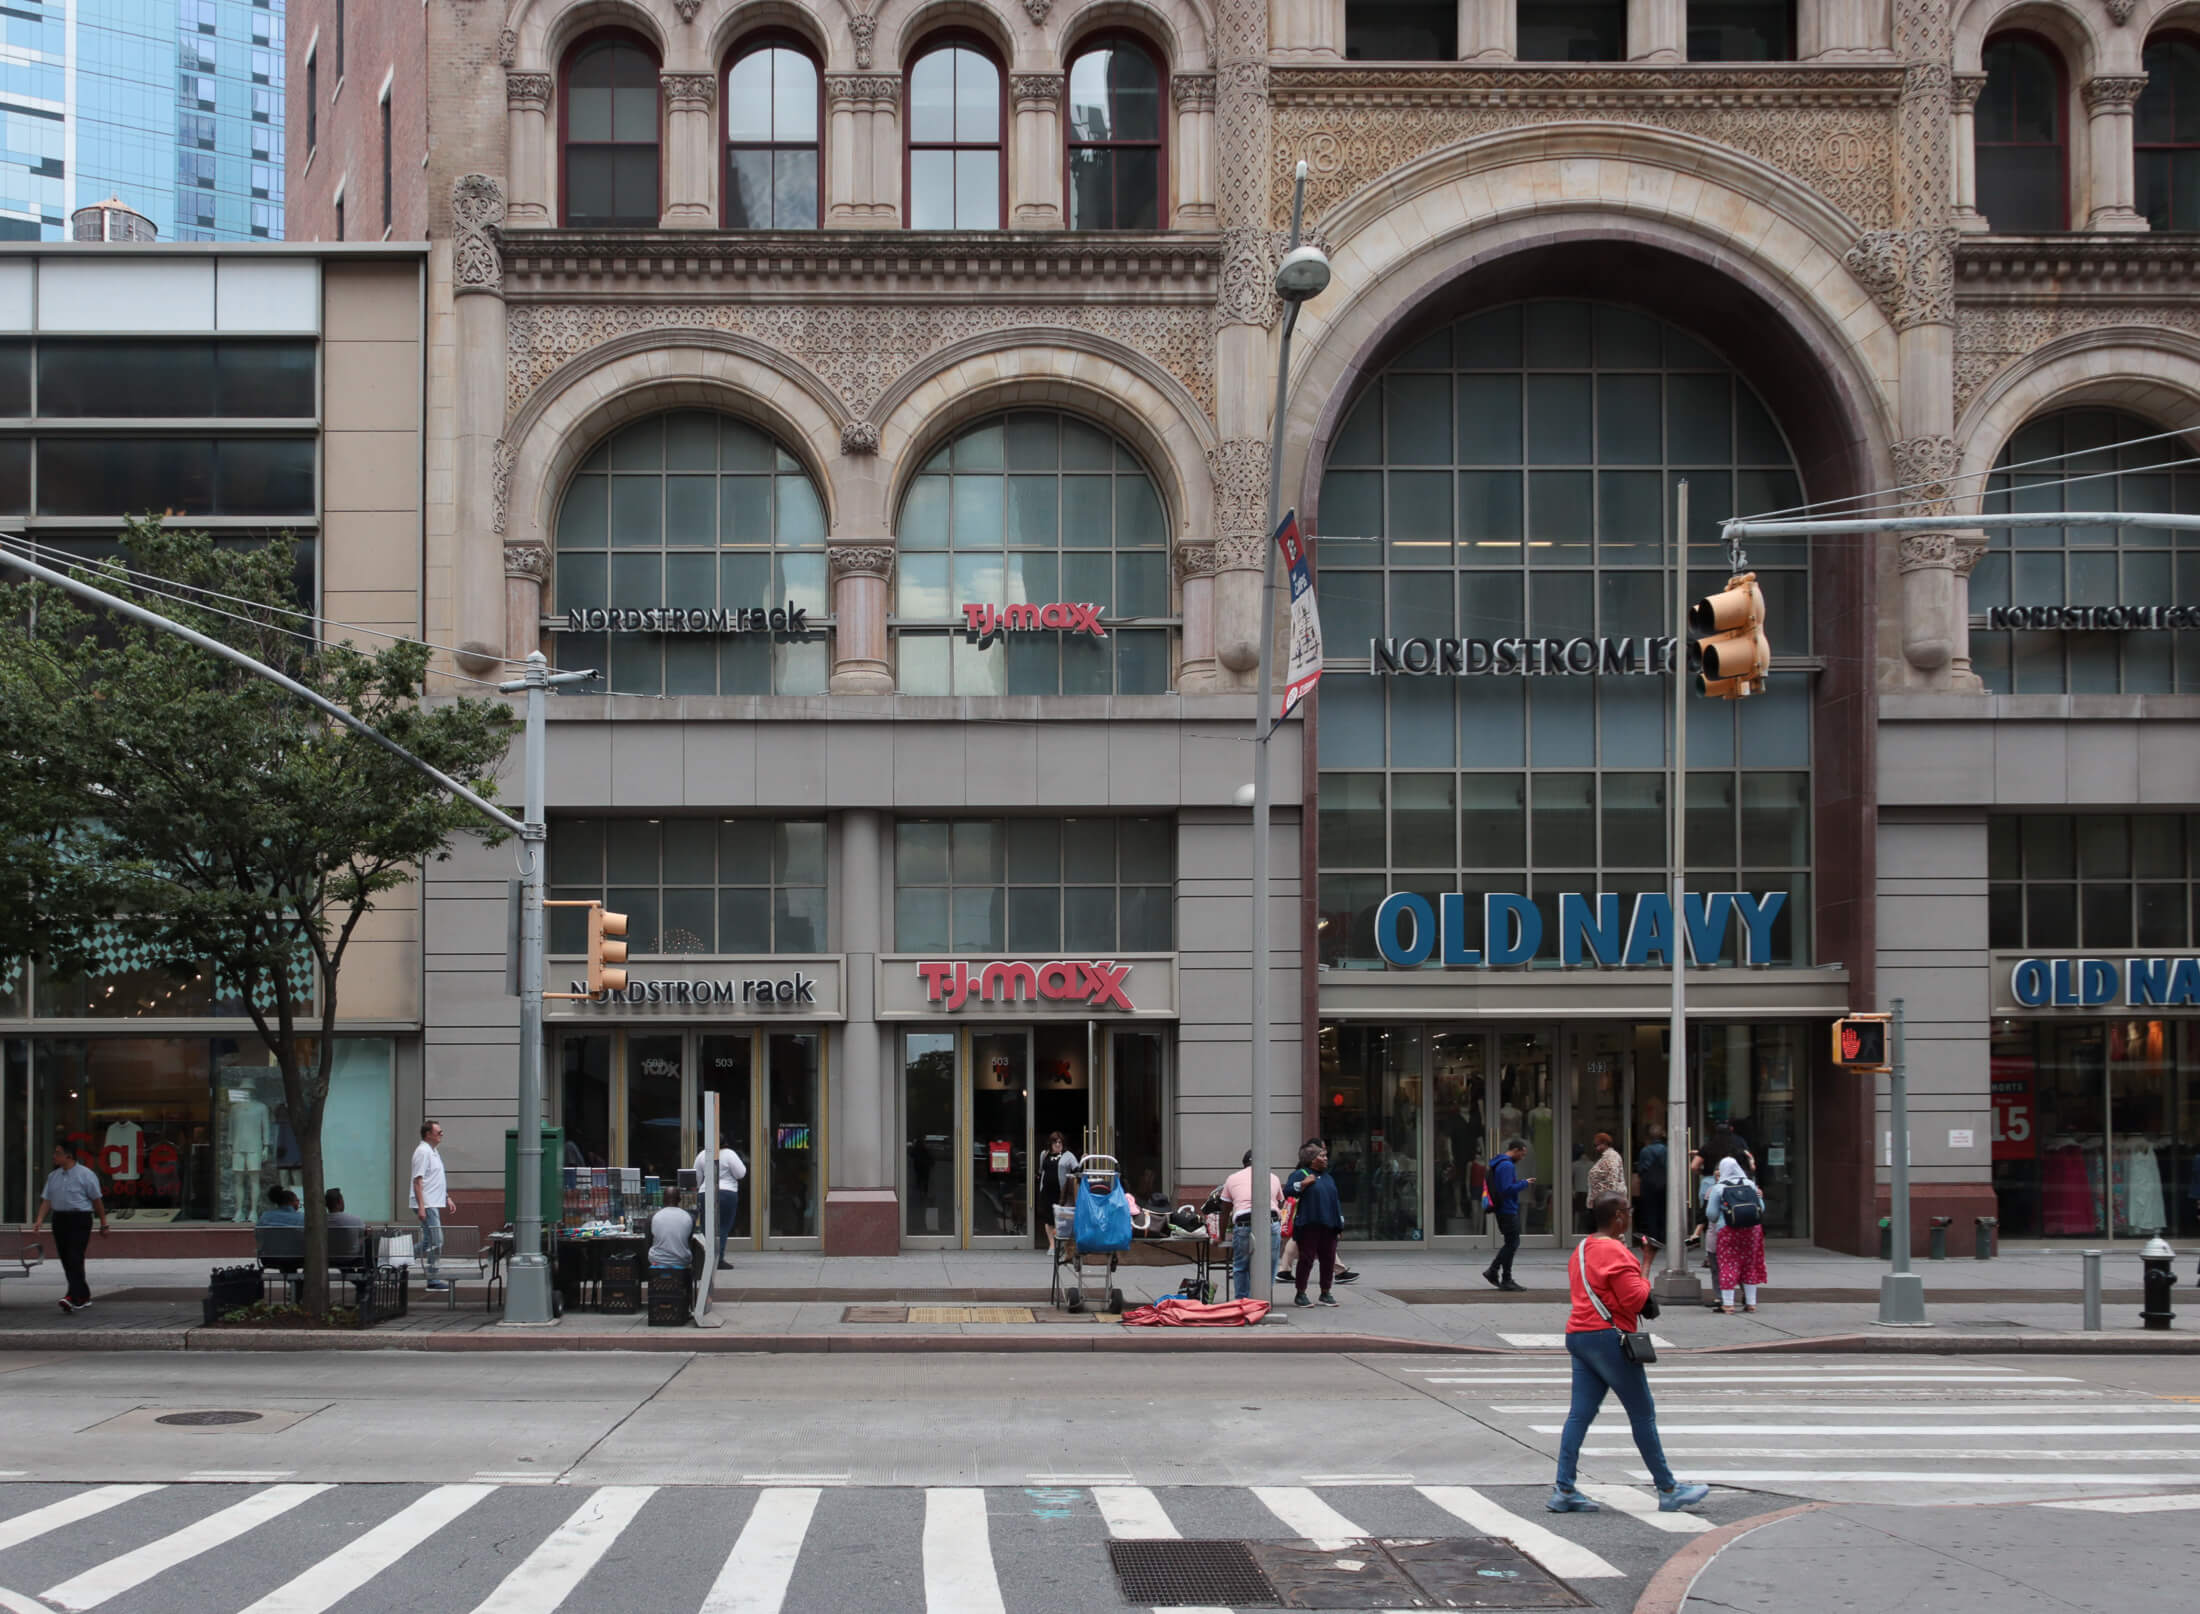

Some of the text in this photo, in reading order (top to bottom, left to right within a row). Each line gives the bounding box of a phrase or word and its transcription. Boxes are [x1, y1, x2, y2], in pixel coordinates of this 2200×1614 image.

[1828, 137, 1862, 174] 90
[567, 600, 811, 632] NORDSTROM rack
[1986, 606, 2150, 631] NORDSTROM
[1370, 637, 1638, 676] NORDSTROM
[1375, 891, 1789, 968] OLD NAVY
[741, 972, 816, 1005] rack
[2011, 958, 2200, 1007] OLD NA
[715, 1058, 734, 1068] 503
[66, 1131, 179, 1174] Sale
[777, 1128, 809, 1149] PRIDE
